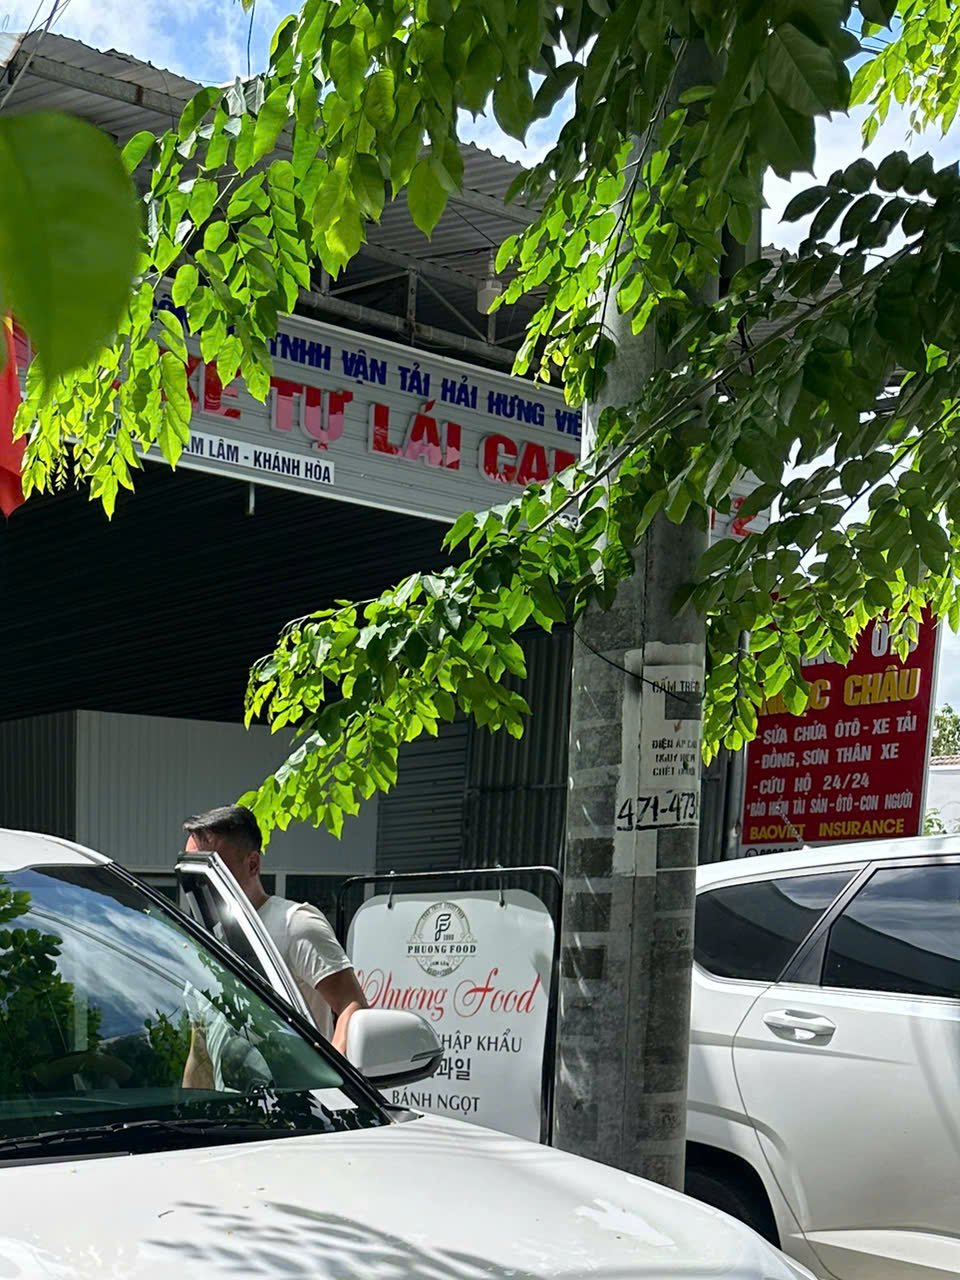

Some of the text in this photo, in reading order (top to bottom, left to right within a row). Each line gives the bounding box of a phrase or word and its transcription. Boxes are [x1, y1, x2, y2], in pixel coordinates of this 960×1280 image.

[342, 349, 388, 386] VẬN
[398, 362, 431, 398] TẢI
[441, 375, 478, 410] HẢI
[487, 390, 546, 427] HƯNG
[555, 408, 583, 442] VIỆ
[368, 399, 463, 471] LÁI
[208, 438, 240, 464] LÂM
[253, 449, 301, 477] KHÁNH
[304, 459, 332, 484] HÒA
[843, 664, 922, 707] CHÂU
[871, 716, 890, 735] XE
[896, 709, 918, 733] TẢI
[836, 743, 872, 764] THÂN
[880, 742, 900, 761] XE
[793, 771, 813, 797] HỘ
[822, 772, 871, 792] 24/24
[818, 817, 906, 838] INSURANCE
[407, 944, 477, 954] PHUONG FOOD
[452, 967, 542, 1018] Food
[437, 1028, 523, 1054] HẬP KHẨU
[432, 1057, 471, 1081] 과일
[392, 1086, 481, 1115] BÁNH NGỌT
